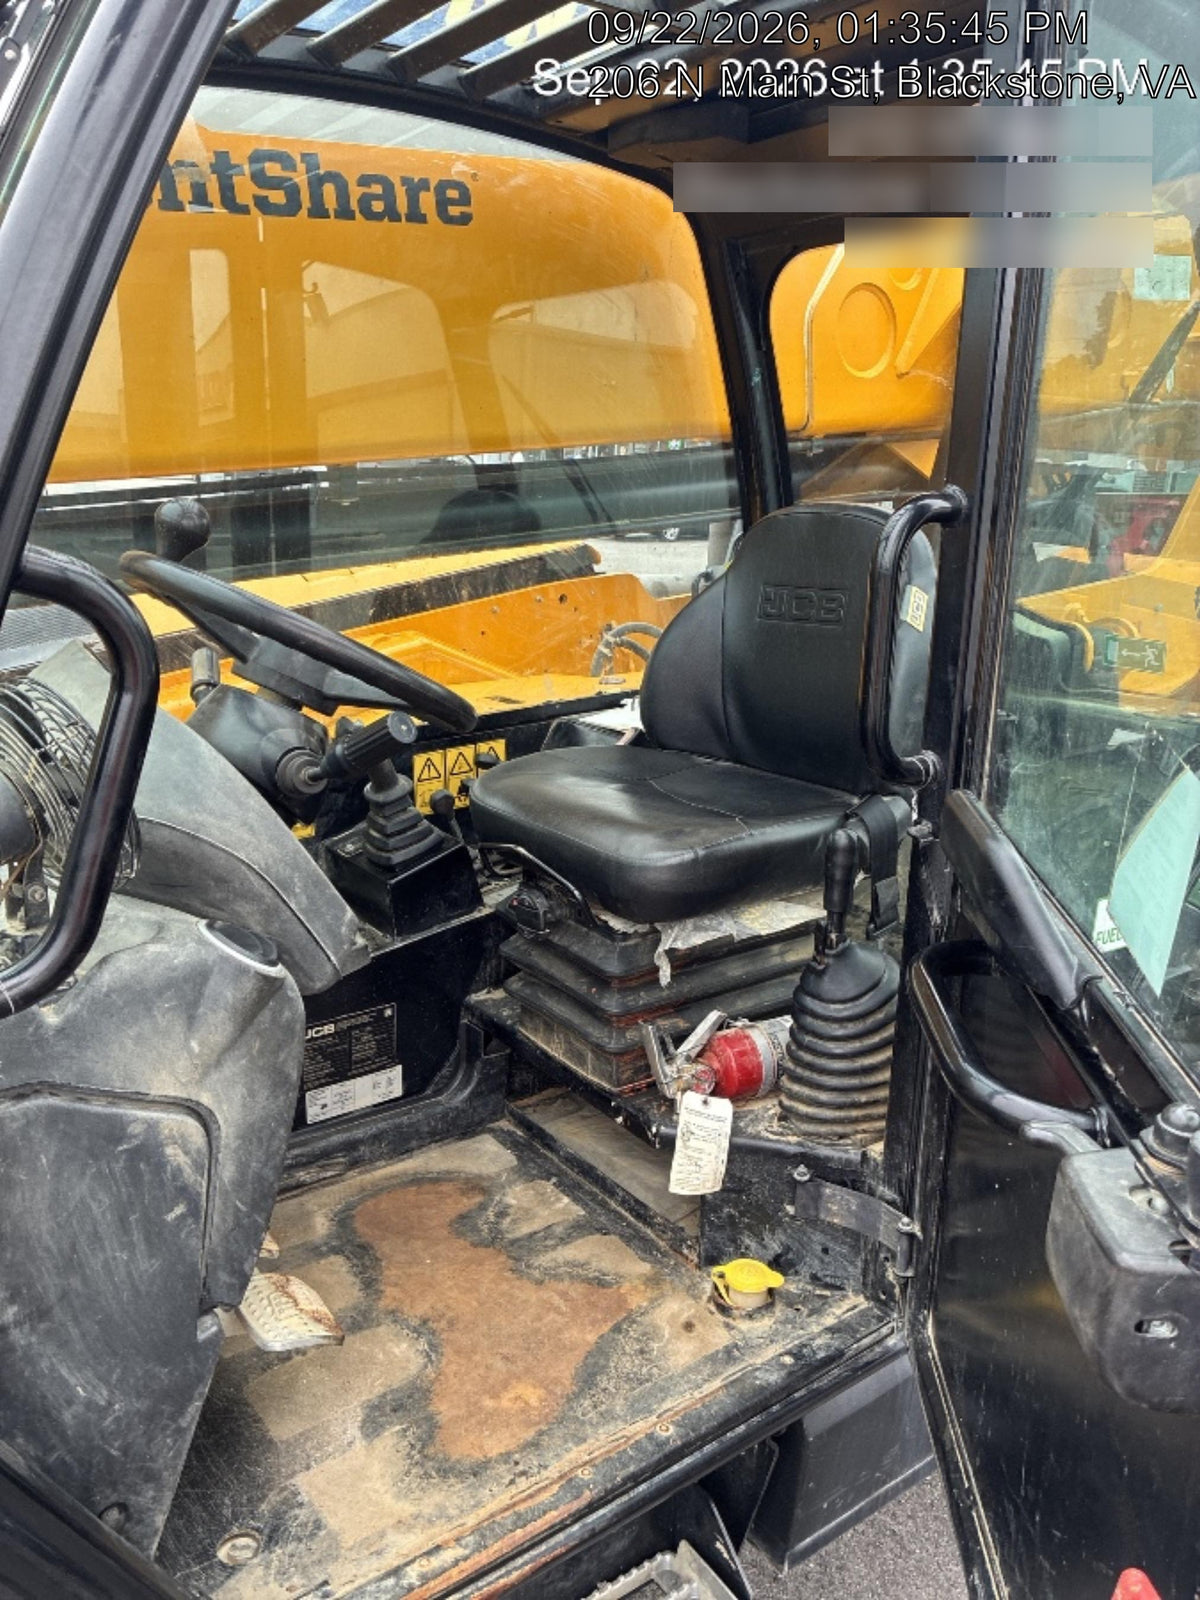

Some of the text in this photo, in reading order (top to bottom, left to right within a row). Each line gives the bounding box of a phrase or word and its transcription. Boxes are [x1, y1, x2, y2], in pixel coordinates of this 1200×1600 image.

[147, 147, 474, 226] ntShare
[759, 585, 845, 625] JCB
[304, 1023, 335, 1040] JCB
